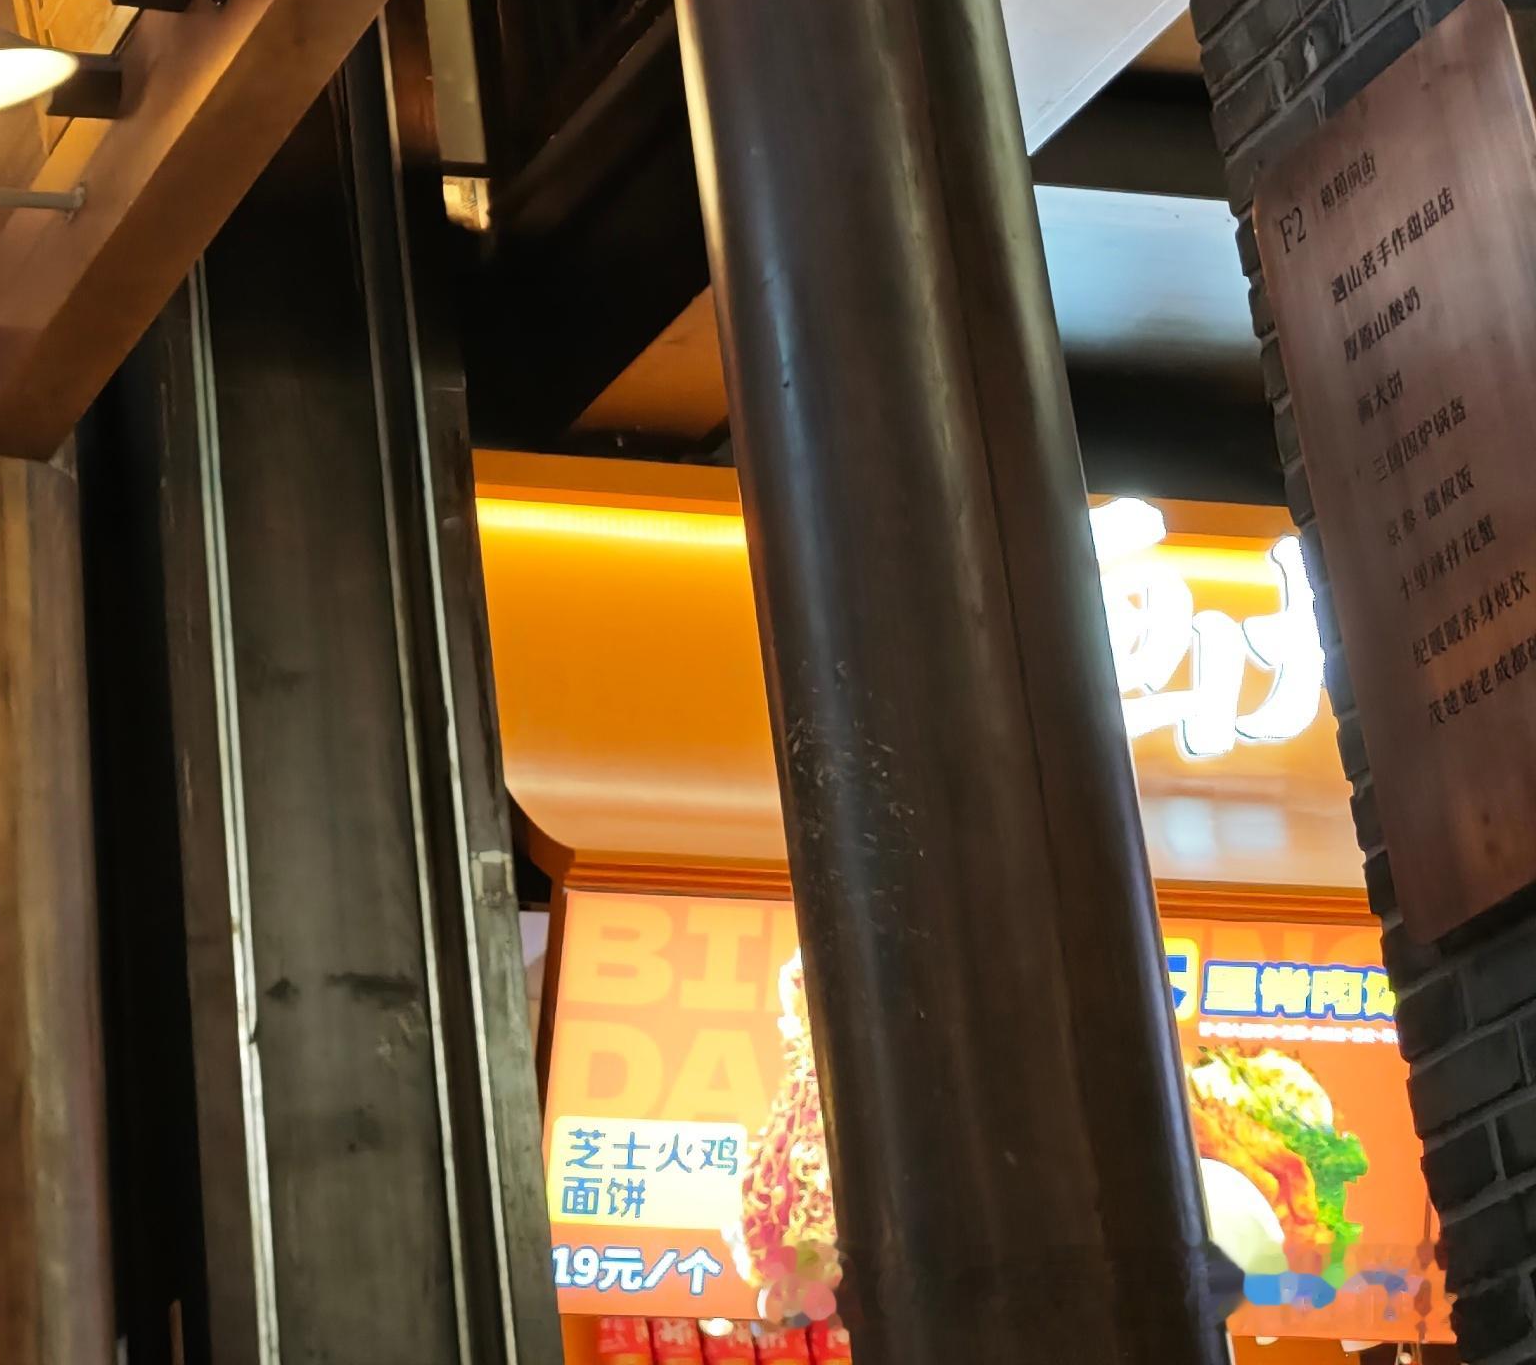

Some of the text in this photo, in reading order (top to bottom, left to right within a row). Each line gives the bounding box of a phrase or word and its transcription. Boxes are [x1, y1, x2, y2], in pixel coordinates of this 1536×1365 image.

[1278, 205, 1307, 254] F2
[564, 1128, 738, 1176] 芝士火鸡
[561, 1176, 646, 1218] 面饼
[551, 1244, 723, 1296] 19元/个
